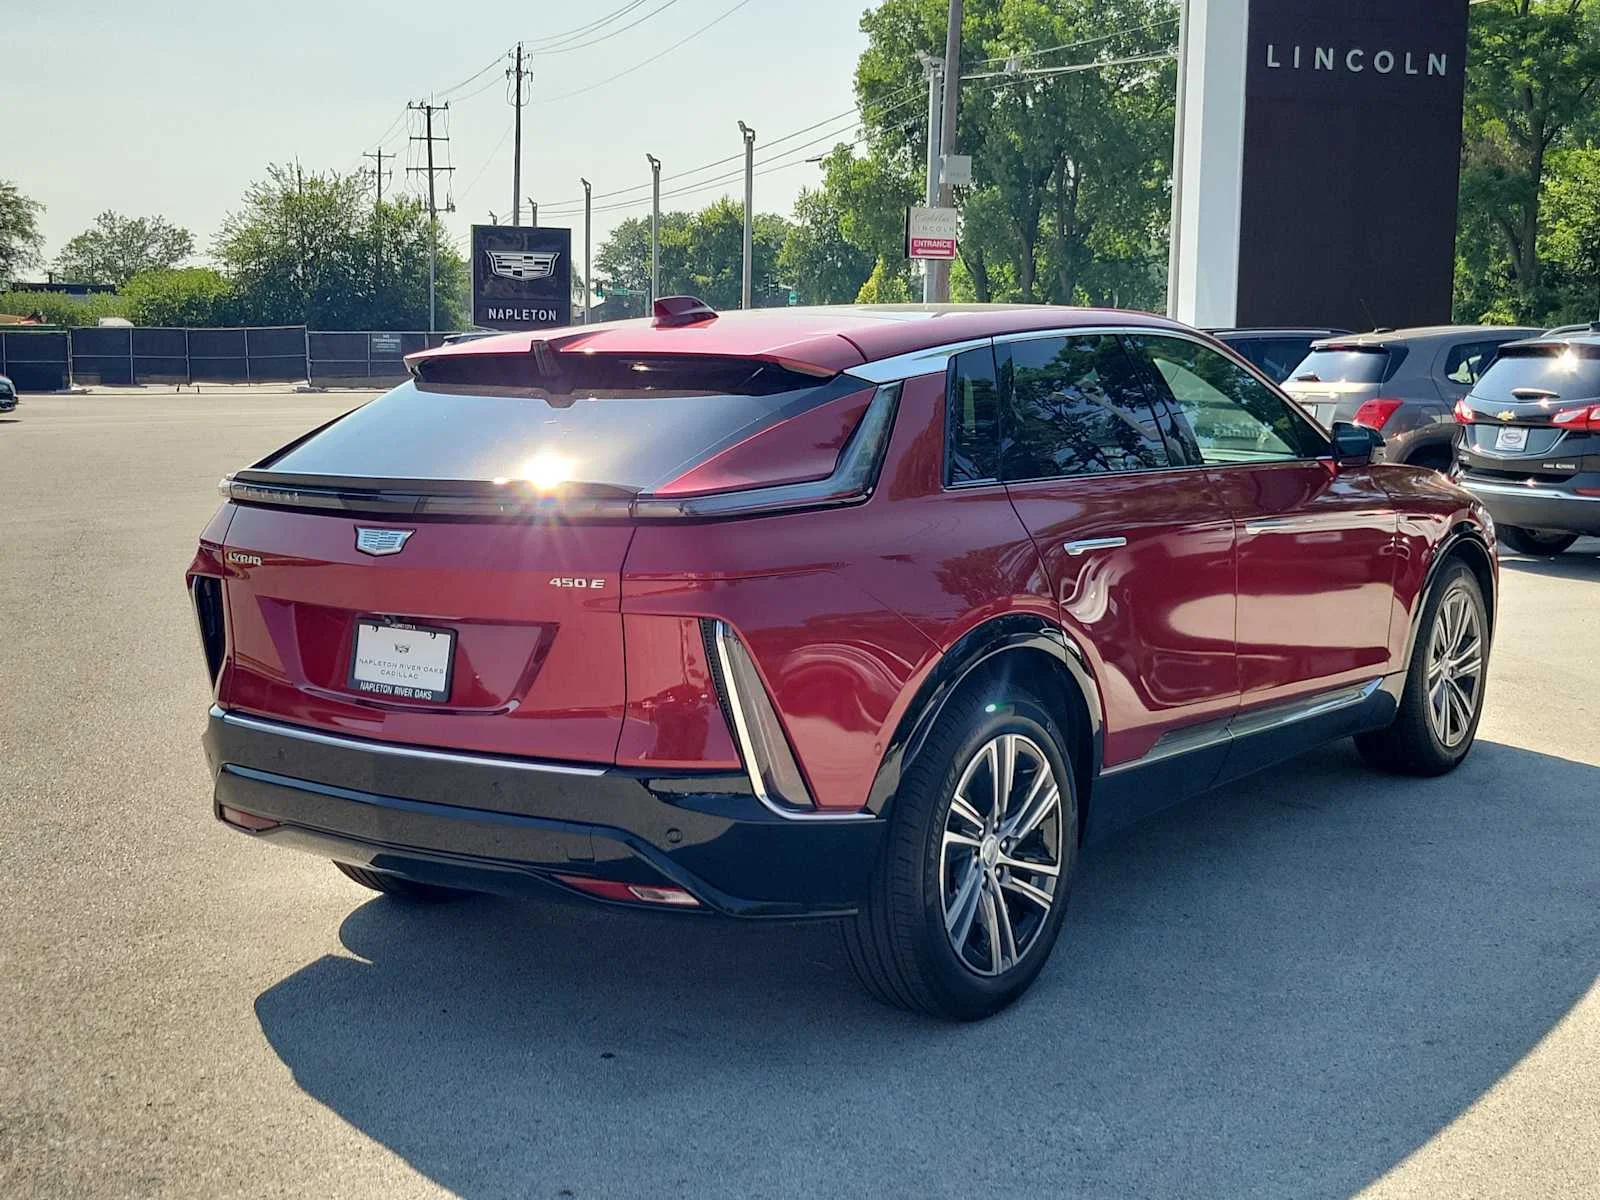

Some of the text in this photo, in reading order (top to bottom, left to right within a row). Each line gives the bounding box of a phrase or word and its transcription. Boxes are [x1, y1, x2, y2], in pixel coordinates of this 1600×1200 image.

[1266, 44, 1447, 76] LINCOLN
[912, 239, 953, 249] ENTRANCE
[488, 308, 557, 321] NAPLETON
[549, 577, 606, 589] 450 E
[359, 658, 444, 674] NAPLETON RIVER OAKS
[380, 669, 419, 680] CADILLAC
[360, 681, 433, 700] NAPLETON RIVER OAKS
